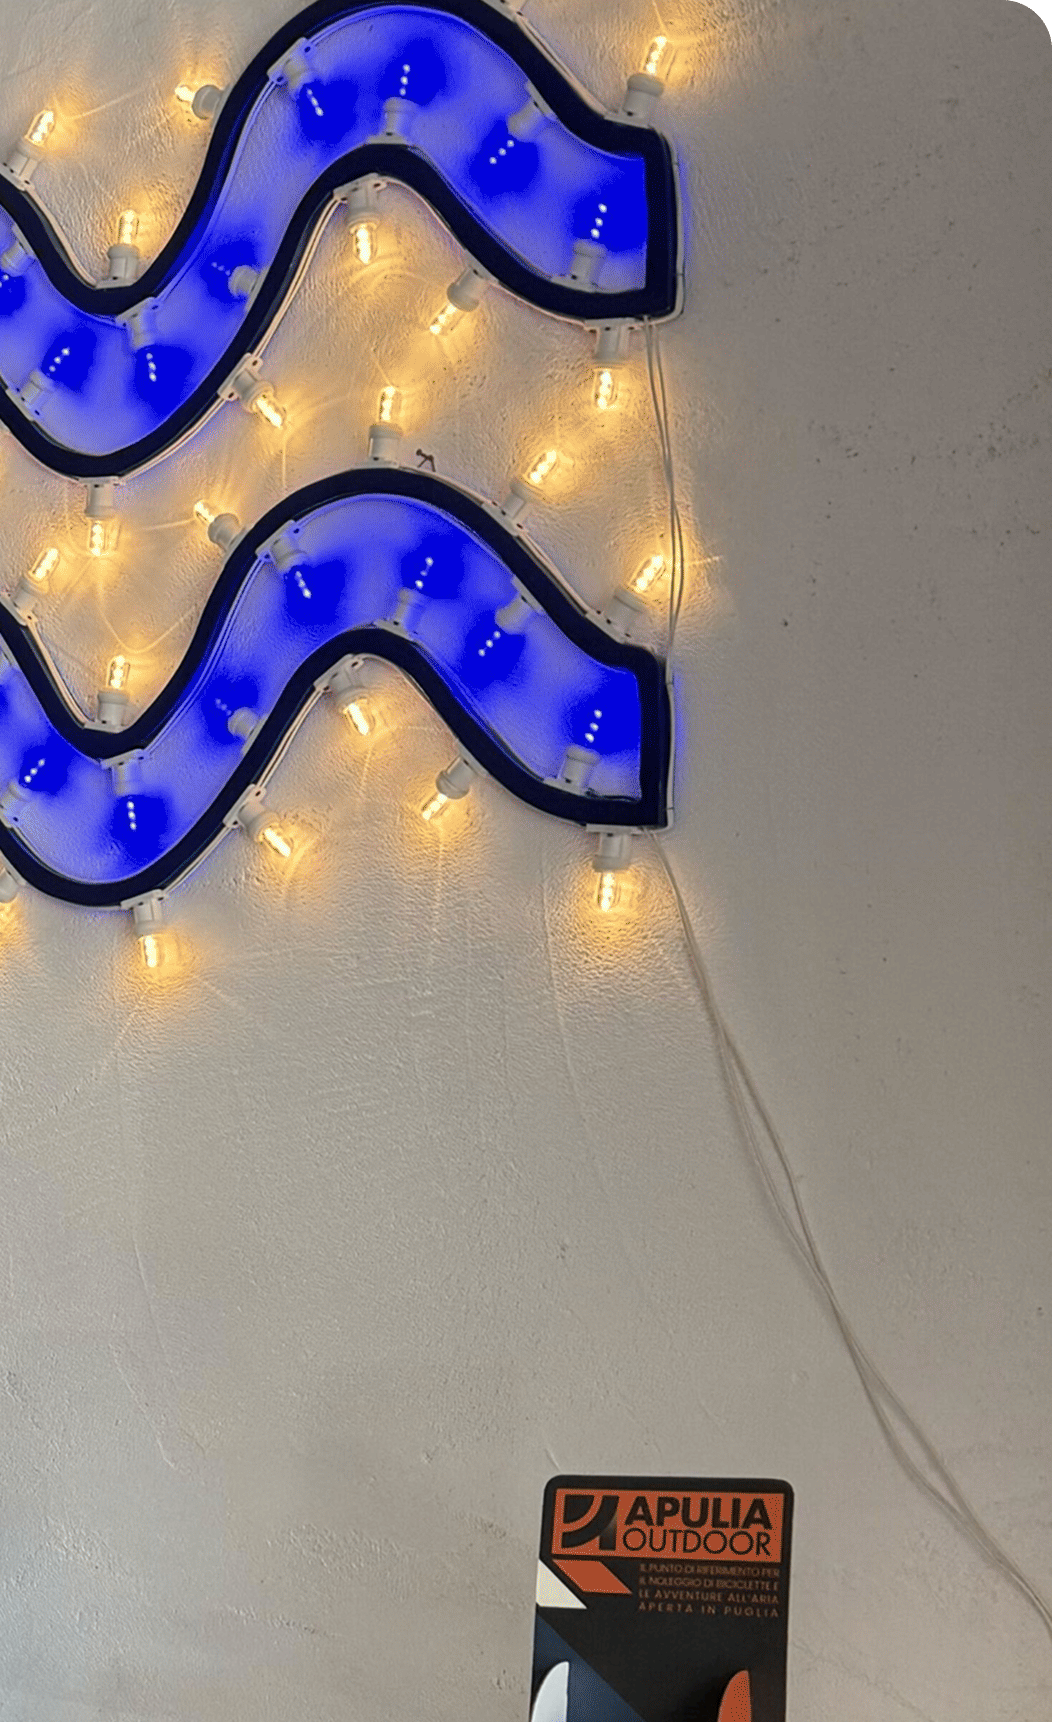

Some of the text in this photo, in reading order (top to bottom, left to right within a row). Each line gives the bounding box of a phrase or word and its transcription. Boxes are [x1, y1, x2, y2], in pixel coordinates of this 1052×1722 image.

[624, 1496, 773, 1530] APULIA
[622, 1527, 771, 1557] OUTDOOR
[649, 1563, 683, 1574] PUNTO
[684, 1564, 695, 1574] DI
[648, 1576, 702, 1587] NOLEGGIO
[703, 1578, 715, 1588] DI
[639, 1588, 780, 1605] LE AVVENTURE ALL'ARIA
[638, 1601, 780, 1618] APERTA IN PUGLIA
